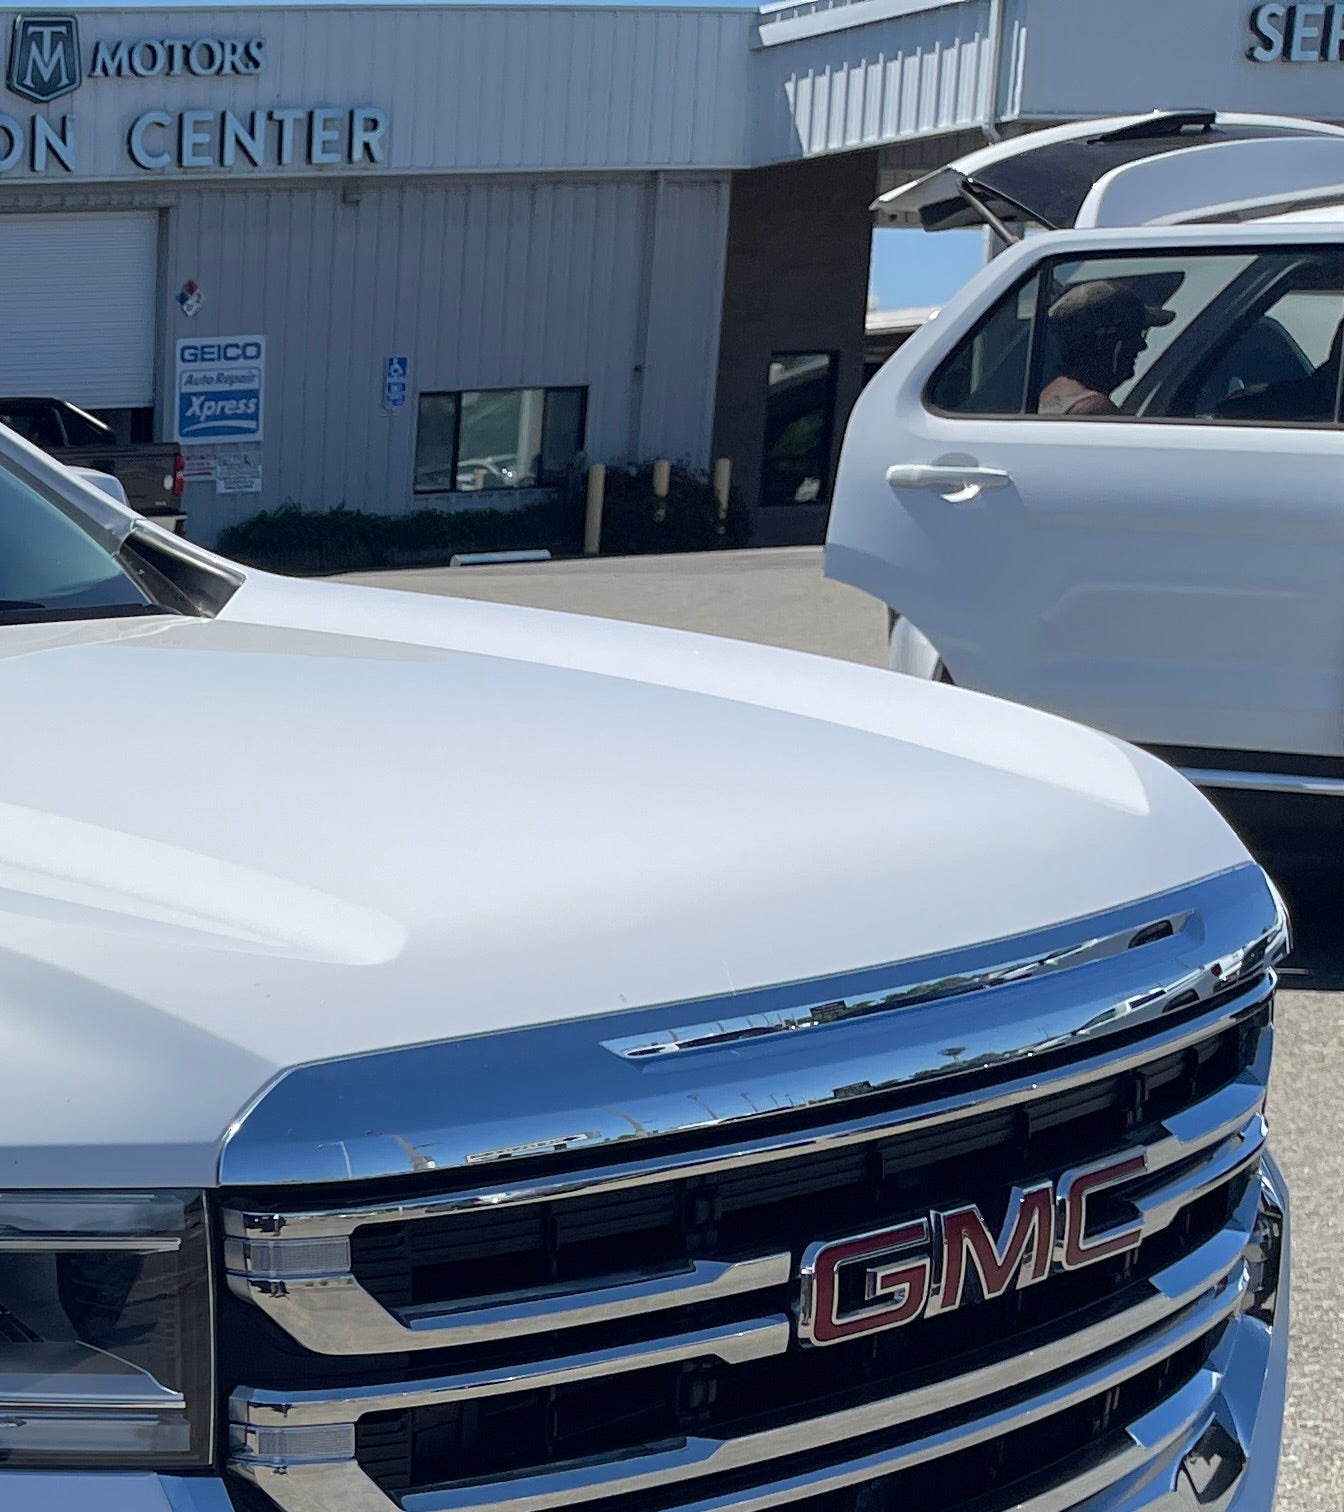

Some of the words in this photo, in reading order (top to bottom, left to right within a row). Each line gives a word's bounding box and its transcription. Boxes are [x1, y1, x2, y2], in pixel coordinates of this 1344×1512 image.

[90, 38, 266, 79] MOTORS
[129, 107, 387, 170] CENTER
[180, 342, 262, 363] GEICO
[183, 373, 214, 386] Auto
[215, 371, 257, 387] Repair
[185, 394, 257, 422] Xpress
[798, 1145, 1148, 1347] GMC
